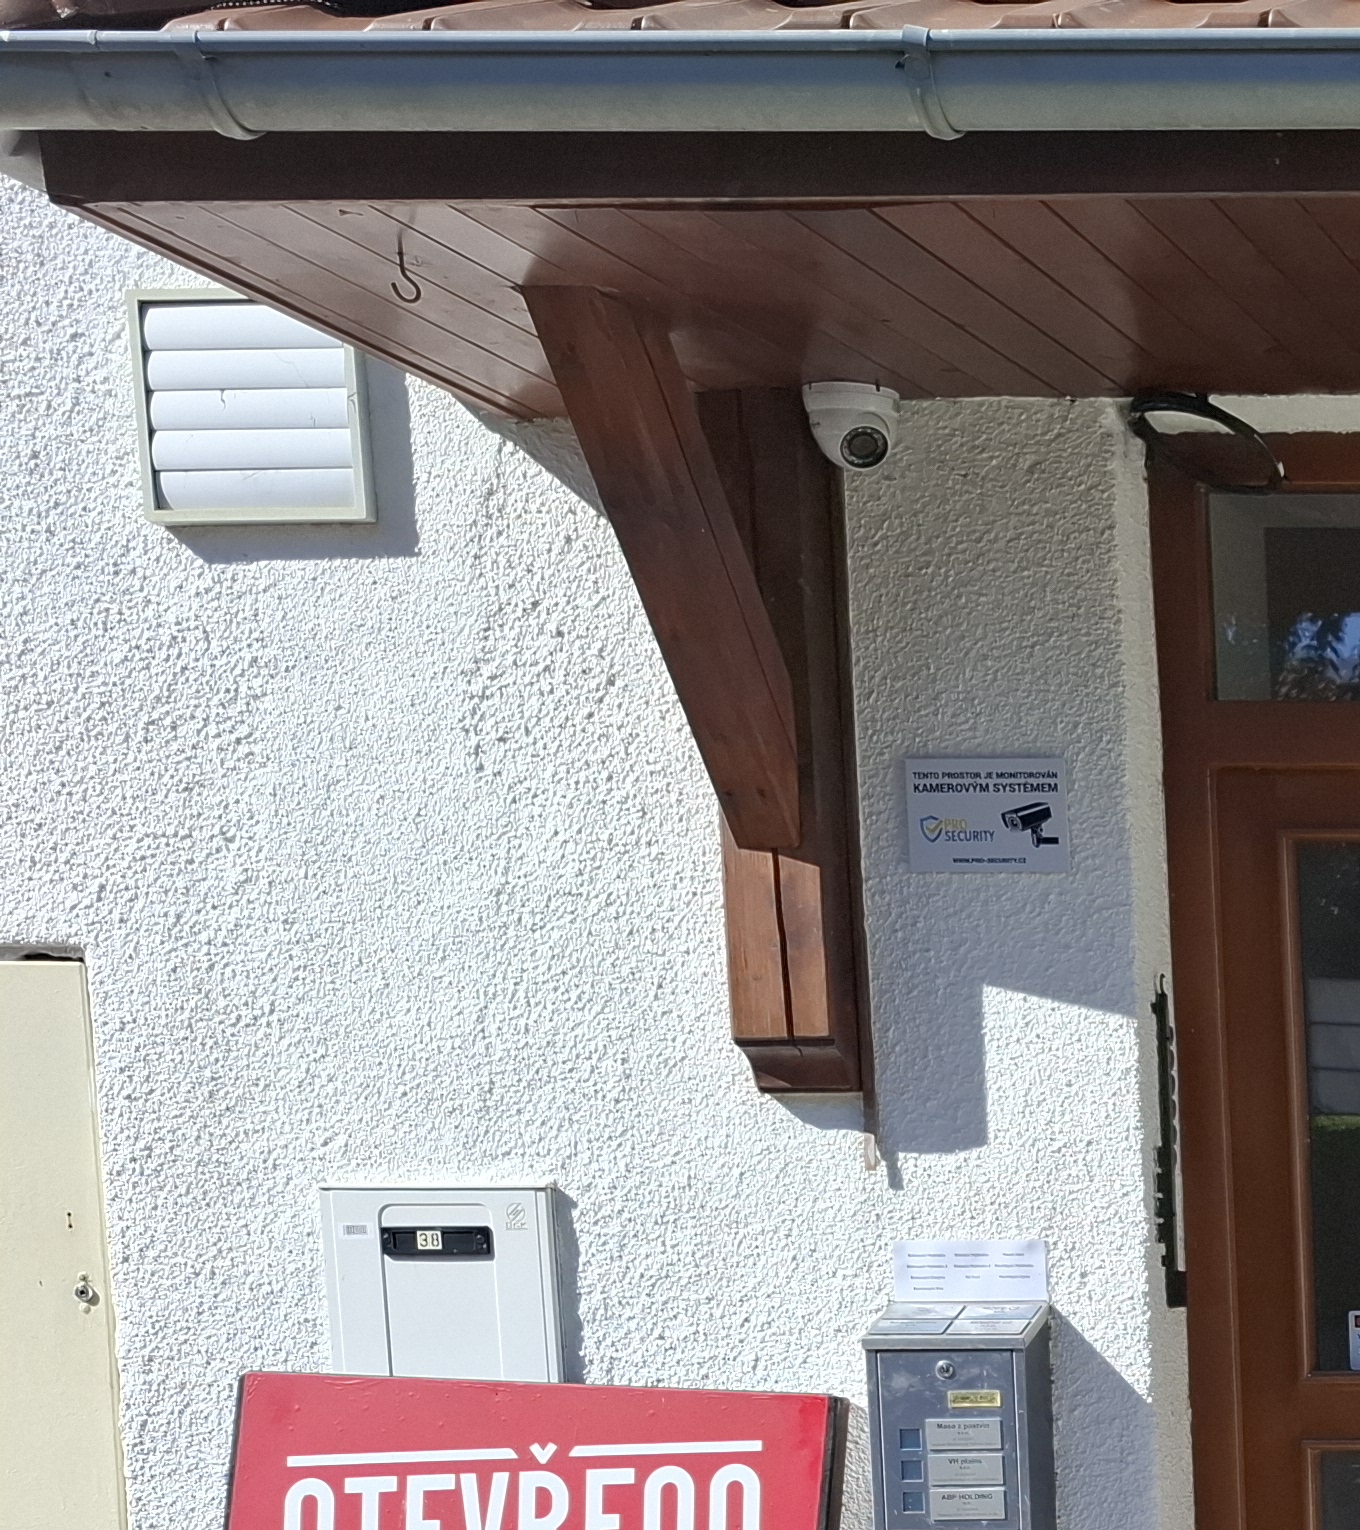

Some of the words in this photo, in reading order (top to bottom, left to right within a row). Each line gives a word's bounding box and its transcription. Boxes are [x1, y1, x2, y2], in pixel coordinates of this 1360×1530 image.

[912, 772, 940, 780] TENTO
[941, 772, 982, 780] PROSTOR
[983, 772, 994, 780] JE
[995, 770, 1058, 779] MONITOROVÁN
[913, 781, 990, 793] KAMEROVÝM
[992, 781, 1059, 793] SYSTÉMEM
[943, 818, 967, 830] PRO
[944, 830, 995, 843] SECURITY
[419, 1232, 440, 1248] 38
[963, 1423, 990, 1431] pastvin
